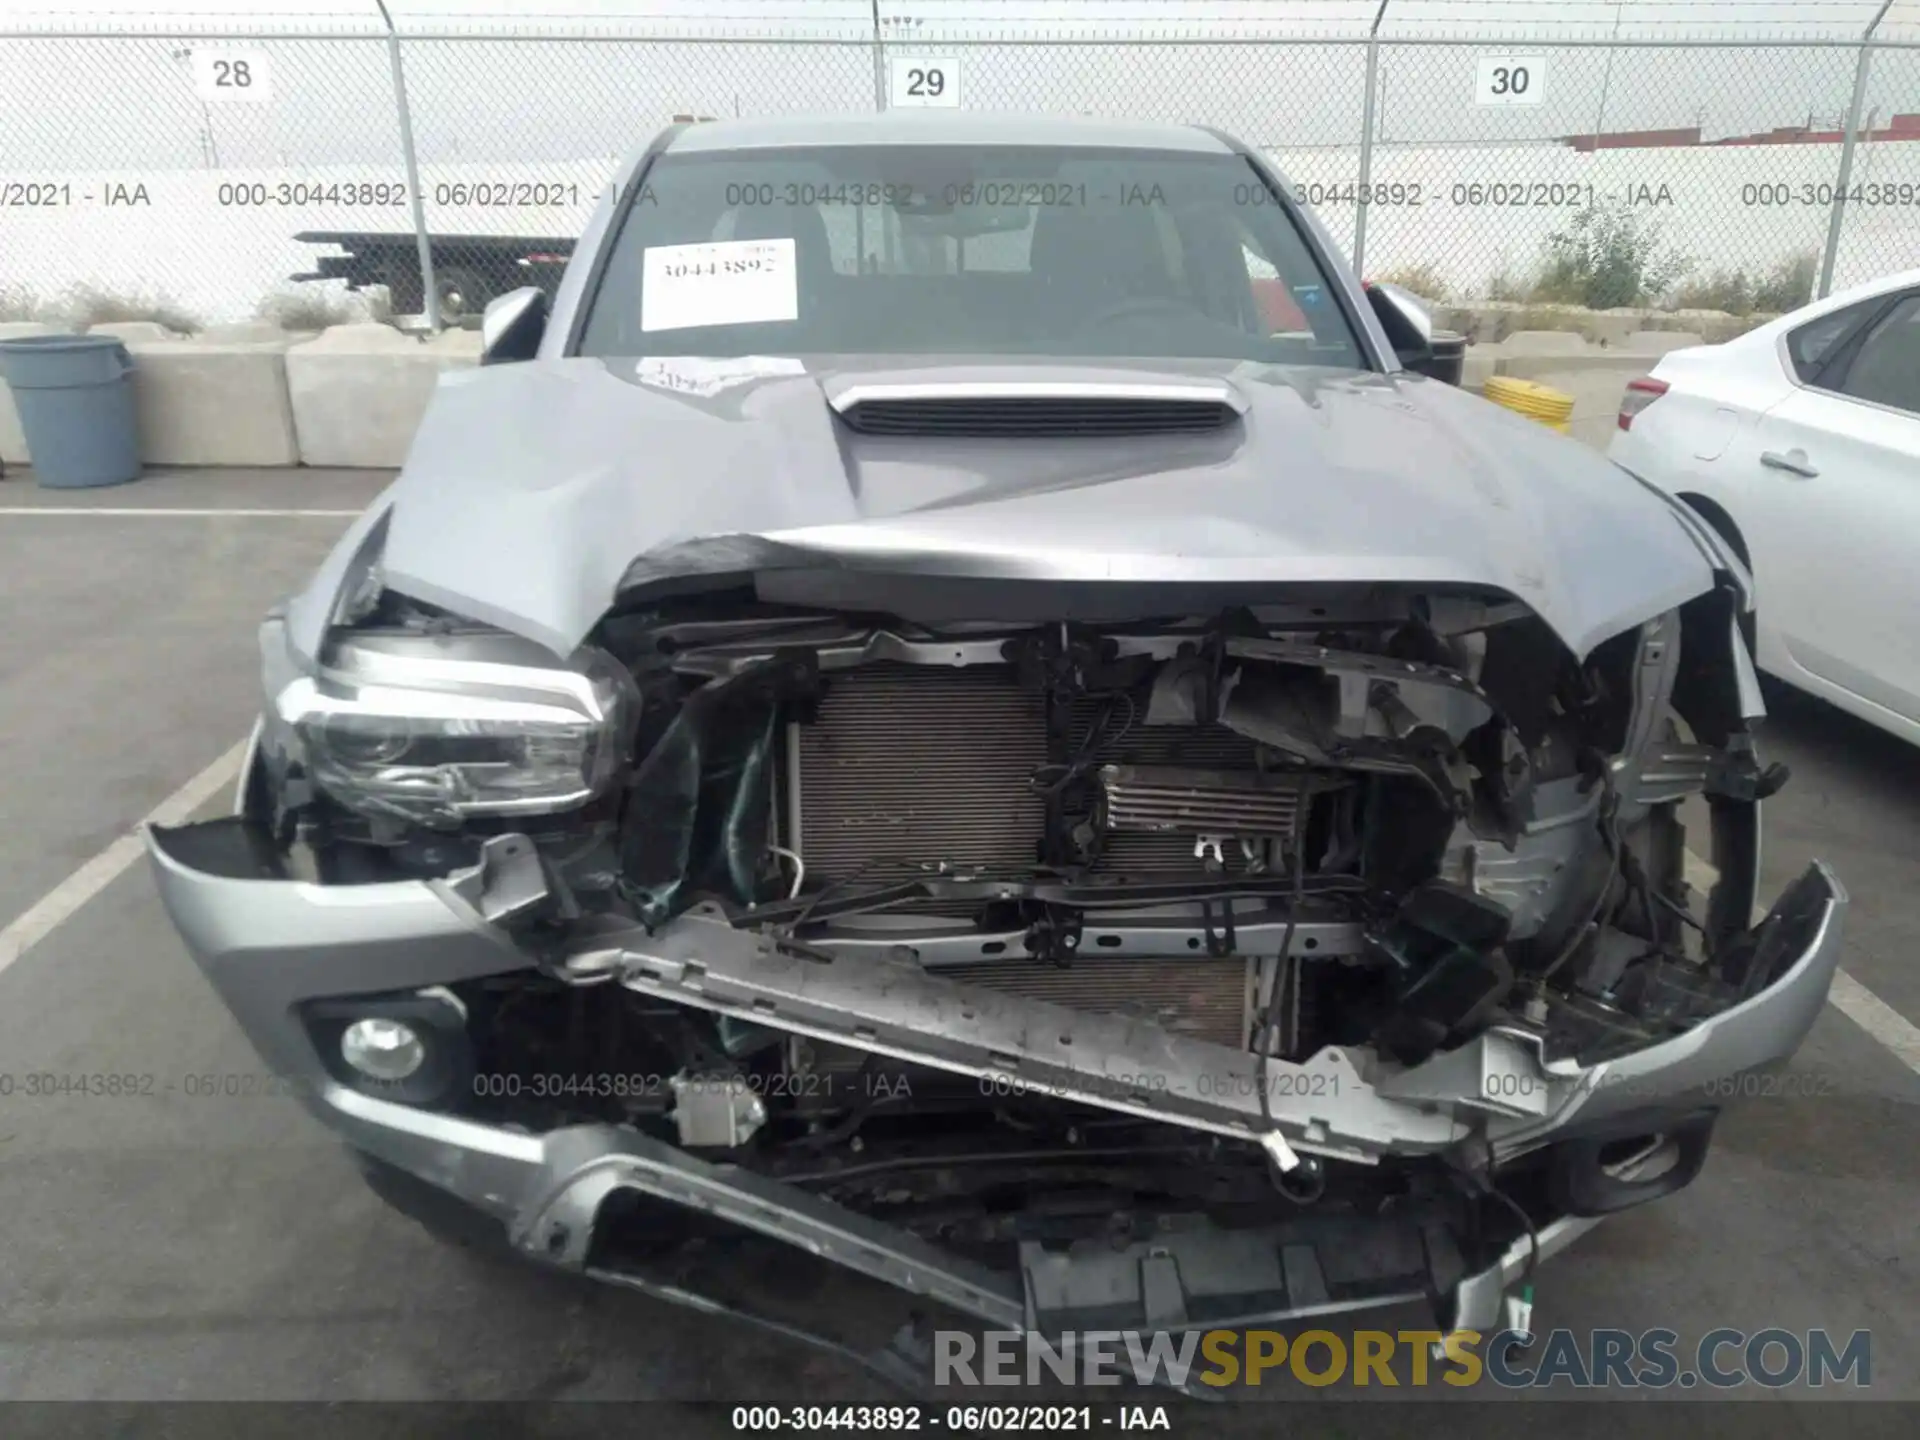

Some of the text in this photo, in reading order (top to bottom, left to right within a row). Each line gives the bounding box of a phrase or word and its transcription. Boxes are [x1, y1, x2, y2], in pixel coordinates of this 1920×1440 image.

[213, 60, 251, 88] 28
[907, 68, 945, 97] 29
[1491, 66, 1530, 95] 30
